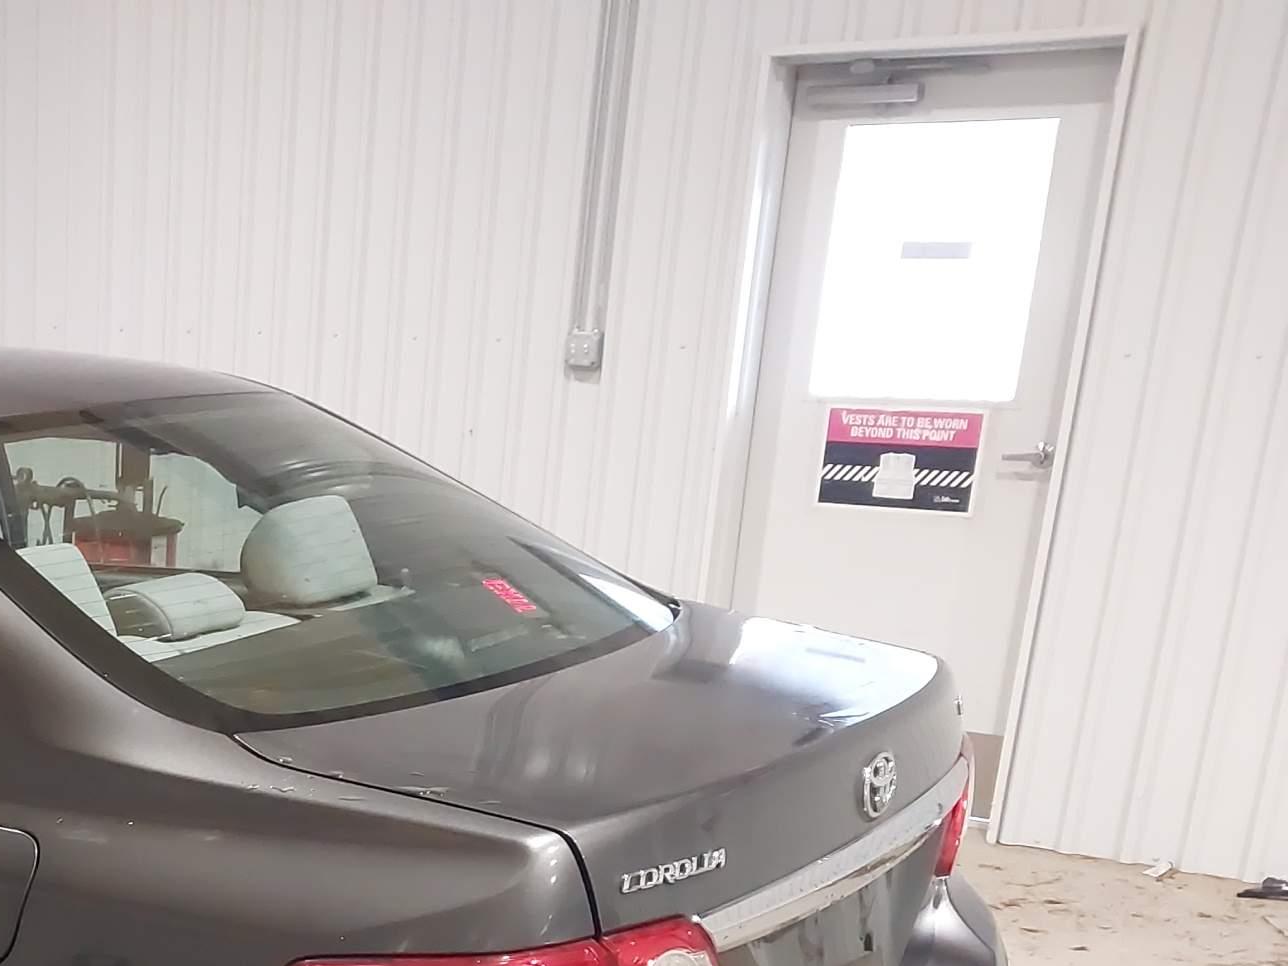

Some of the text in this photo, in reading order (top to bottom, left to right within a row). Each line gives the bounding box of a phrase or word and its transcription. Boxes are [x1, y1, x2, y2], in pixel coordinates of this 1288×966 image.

[841, 411, 875, 426] VESTS
[876, 413, 899, 428] ARE
[900, 415, 915, 428] TO
[933, 418, 969, 431] WORN
[850, 425, 957, 442] BEYOND THIS POINT
[621, 847, 727, 894] COROLLA
